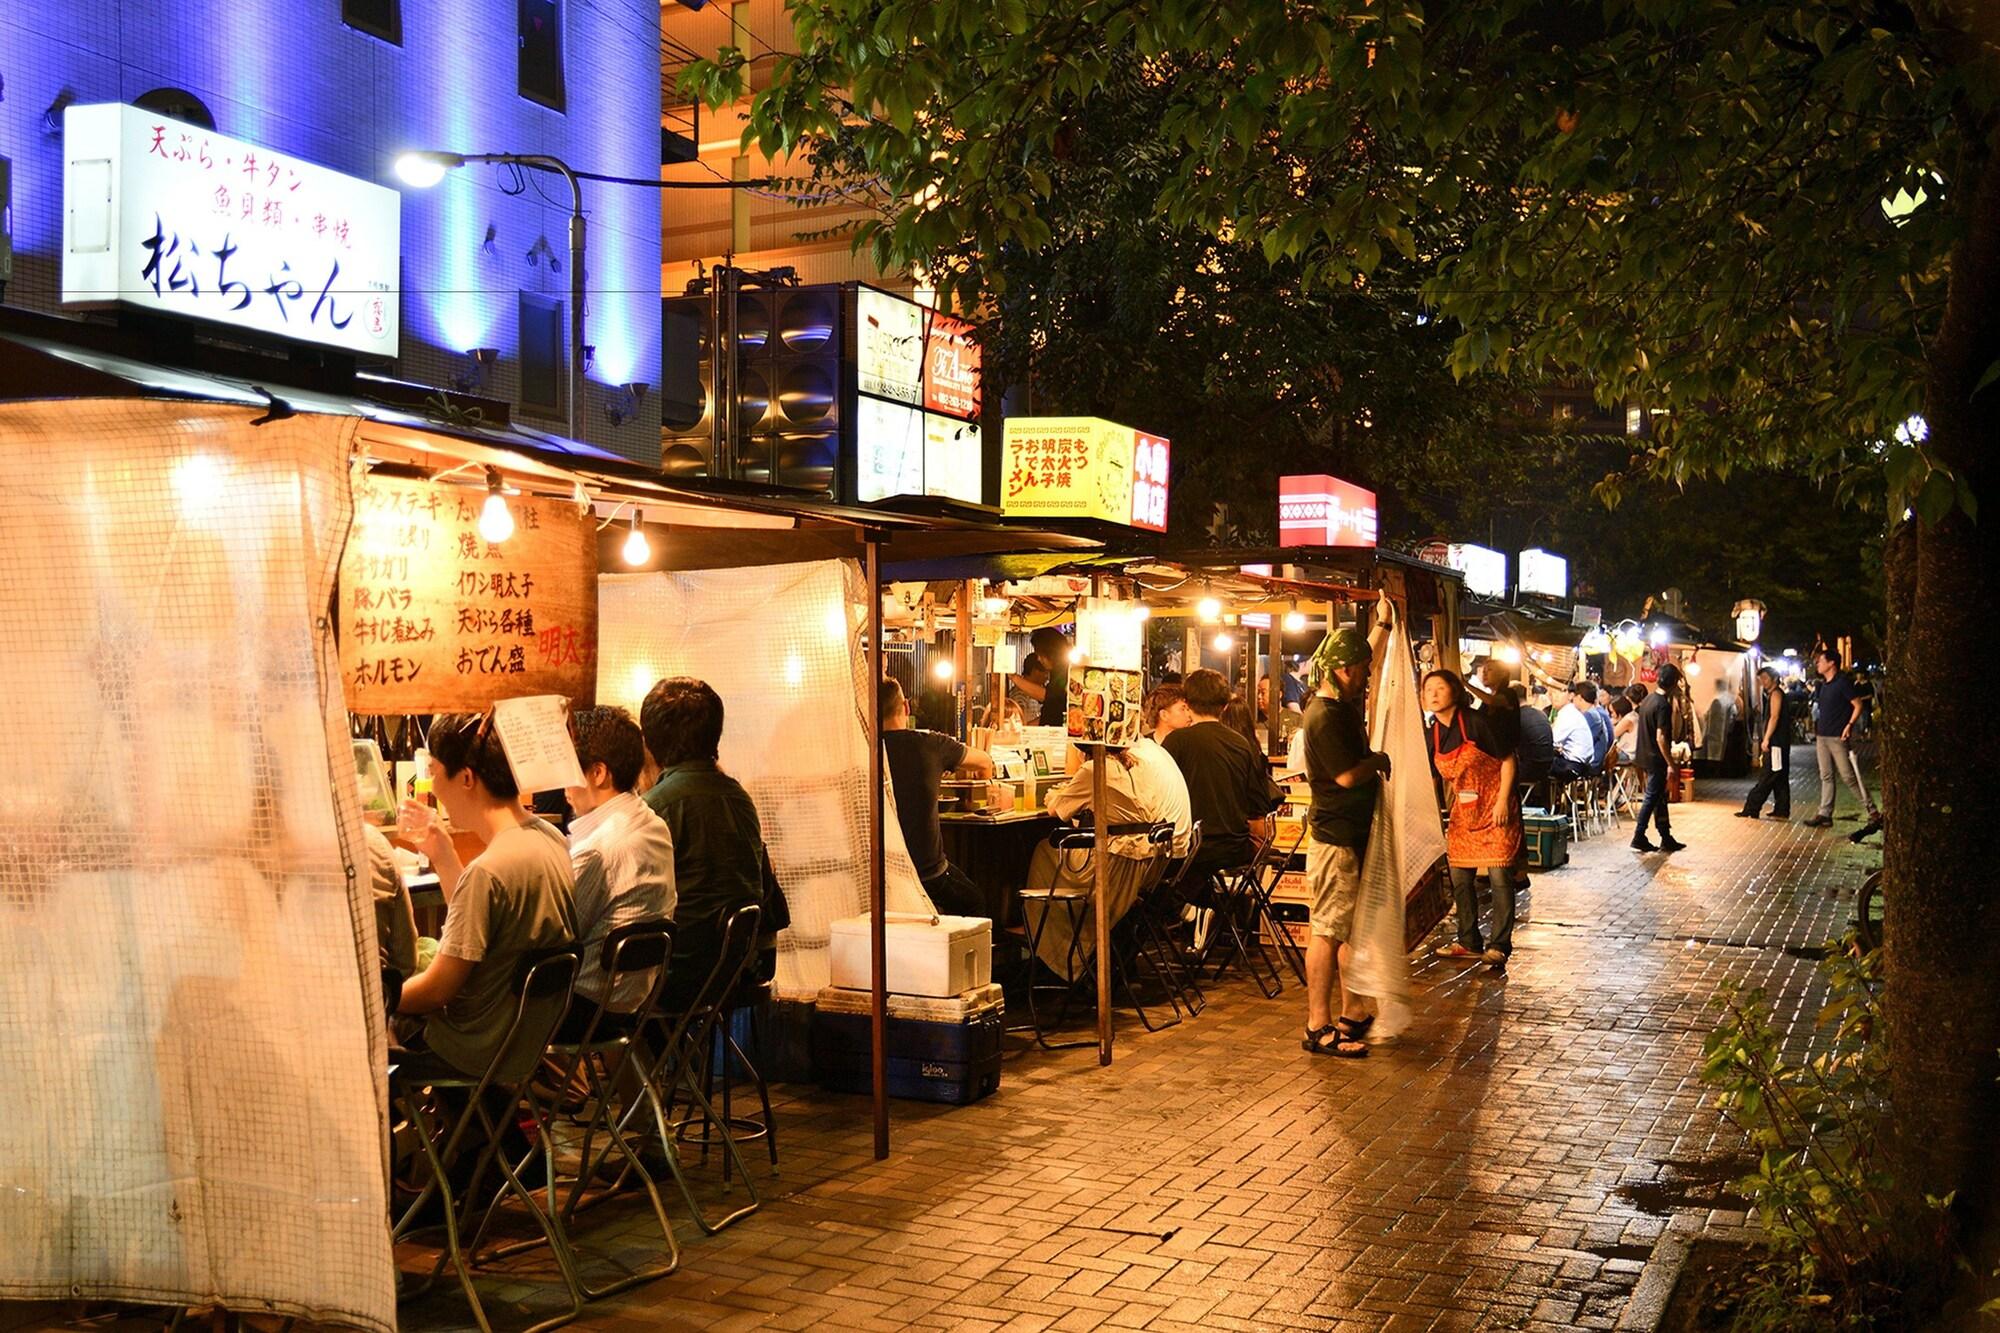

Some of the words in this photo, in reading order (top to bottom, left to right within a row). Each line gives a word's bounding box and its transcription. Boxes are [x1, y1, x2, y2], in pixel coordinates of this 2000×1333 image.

[150, 125, 302, 191] 天ぷら・牛タン
[141, 211, 354, 330] 松ちゃん
[1009, 439, 1024, 498] ラーメン
[1024, 438, 1040, 488] おでん
[1040, 438, 1056, 489] 明太子
[1056, 438, 1073, 488] 炭火焼
[1073, 438, 1089, 470] もつ
[353, 586, 413, 611] 豚バラ
[457, 570, 535, 599] イワシ明太子
[352, 616, 436, 646] 牛すじ煮込み
[457, 608, 536, 637] 天ぷら各種
[353, 657, 424, 686] ホルモン
[456, 644, 526, 675] おでん盛
[921, 1063, 944, 1075] igloo
